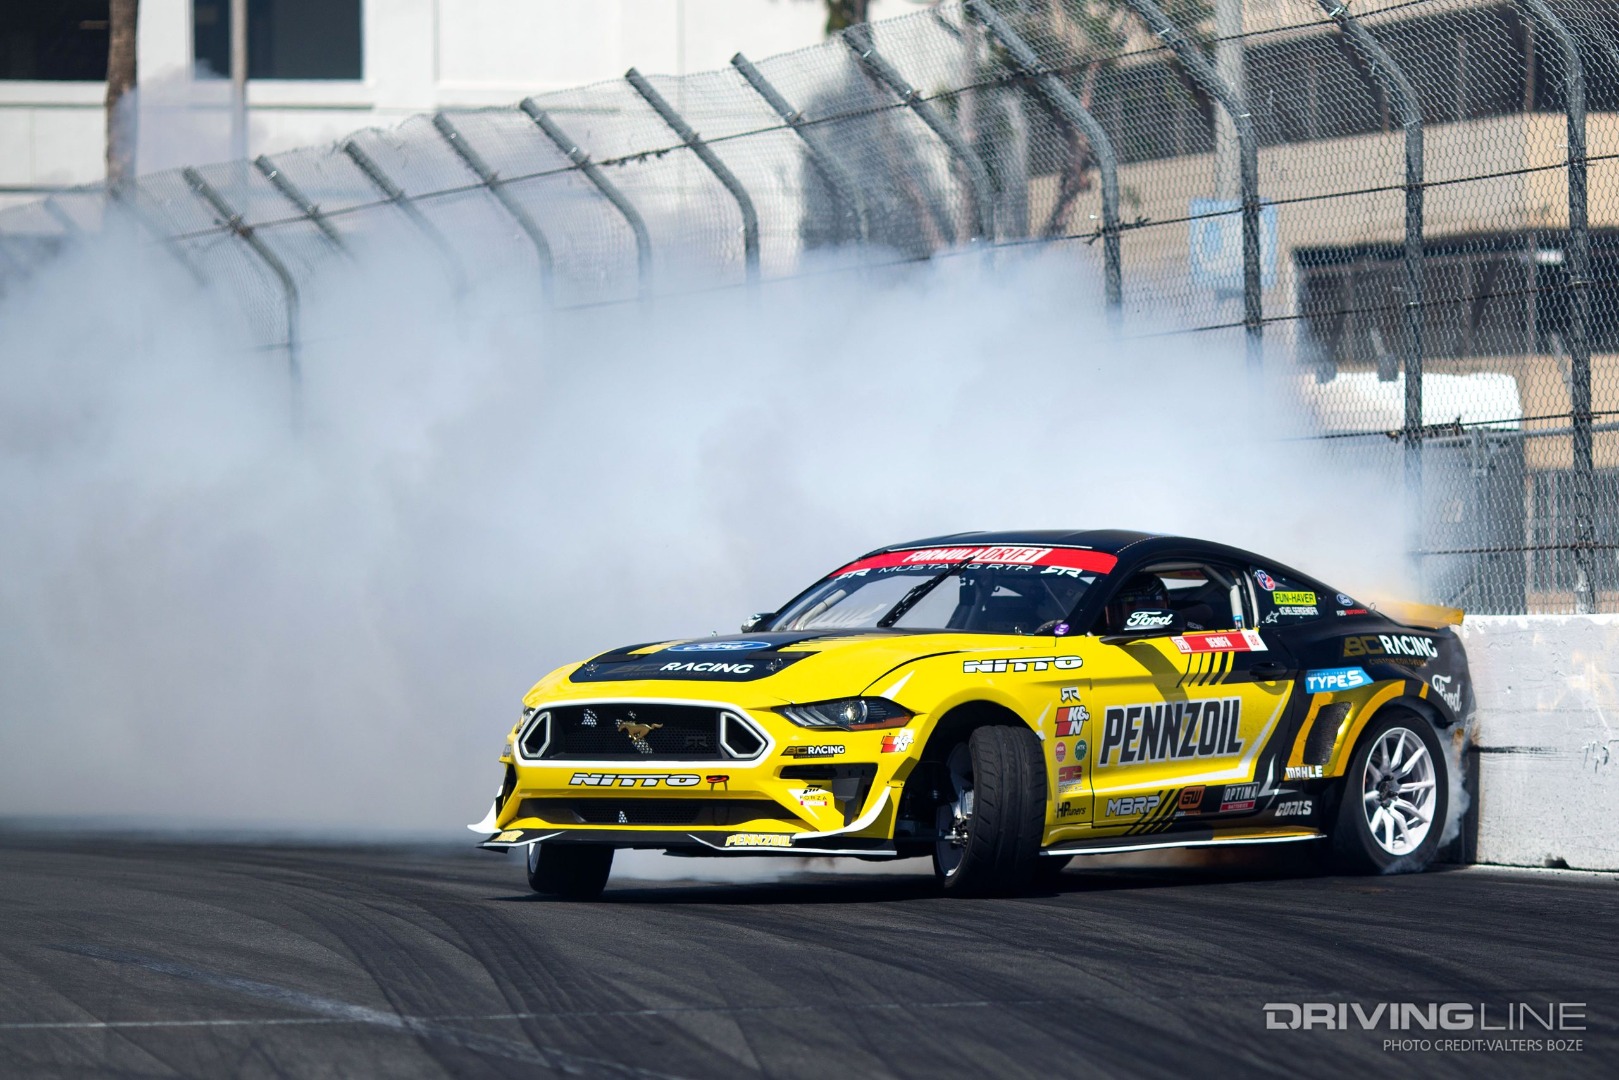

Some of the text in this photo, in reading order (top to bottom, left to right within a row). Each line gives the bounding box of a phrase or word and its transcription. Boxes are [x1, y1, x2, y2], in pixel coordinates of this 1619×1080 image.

[902, 547, 1050, 563] FORMULA DRIFT
[986, 563, 1034, 571] RTR
[1275, 592, 1315, 604] FUN-HAVER
[1126, 611, 1174, 627] Ford
[1378, 634, 1439, 659] RACING
[659, 662, 755, 674] RACING
[963, 655, 1083, 673] NITTO
[1431, 674, 1464, 713] Ford
[1098, 697, 1243, 767] PENNZOIL
[807, 744, 846, 755] RACING
[568, 773, 701, 787] NITTO
[1285, 765, 1323, 779] MAHLE
[1224, 785, 1257, 801] OPTIMA
[1106, 795, 1161, 817] MBRP
[1274, 800, 1313, 817] COATS
[725, 833, 793, 847] PENNZOIL
